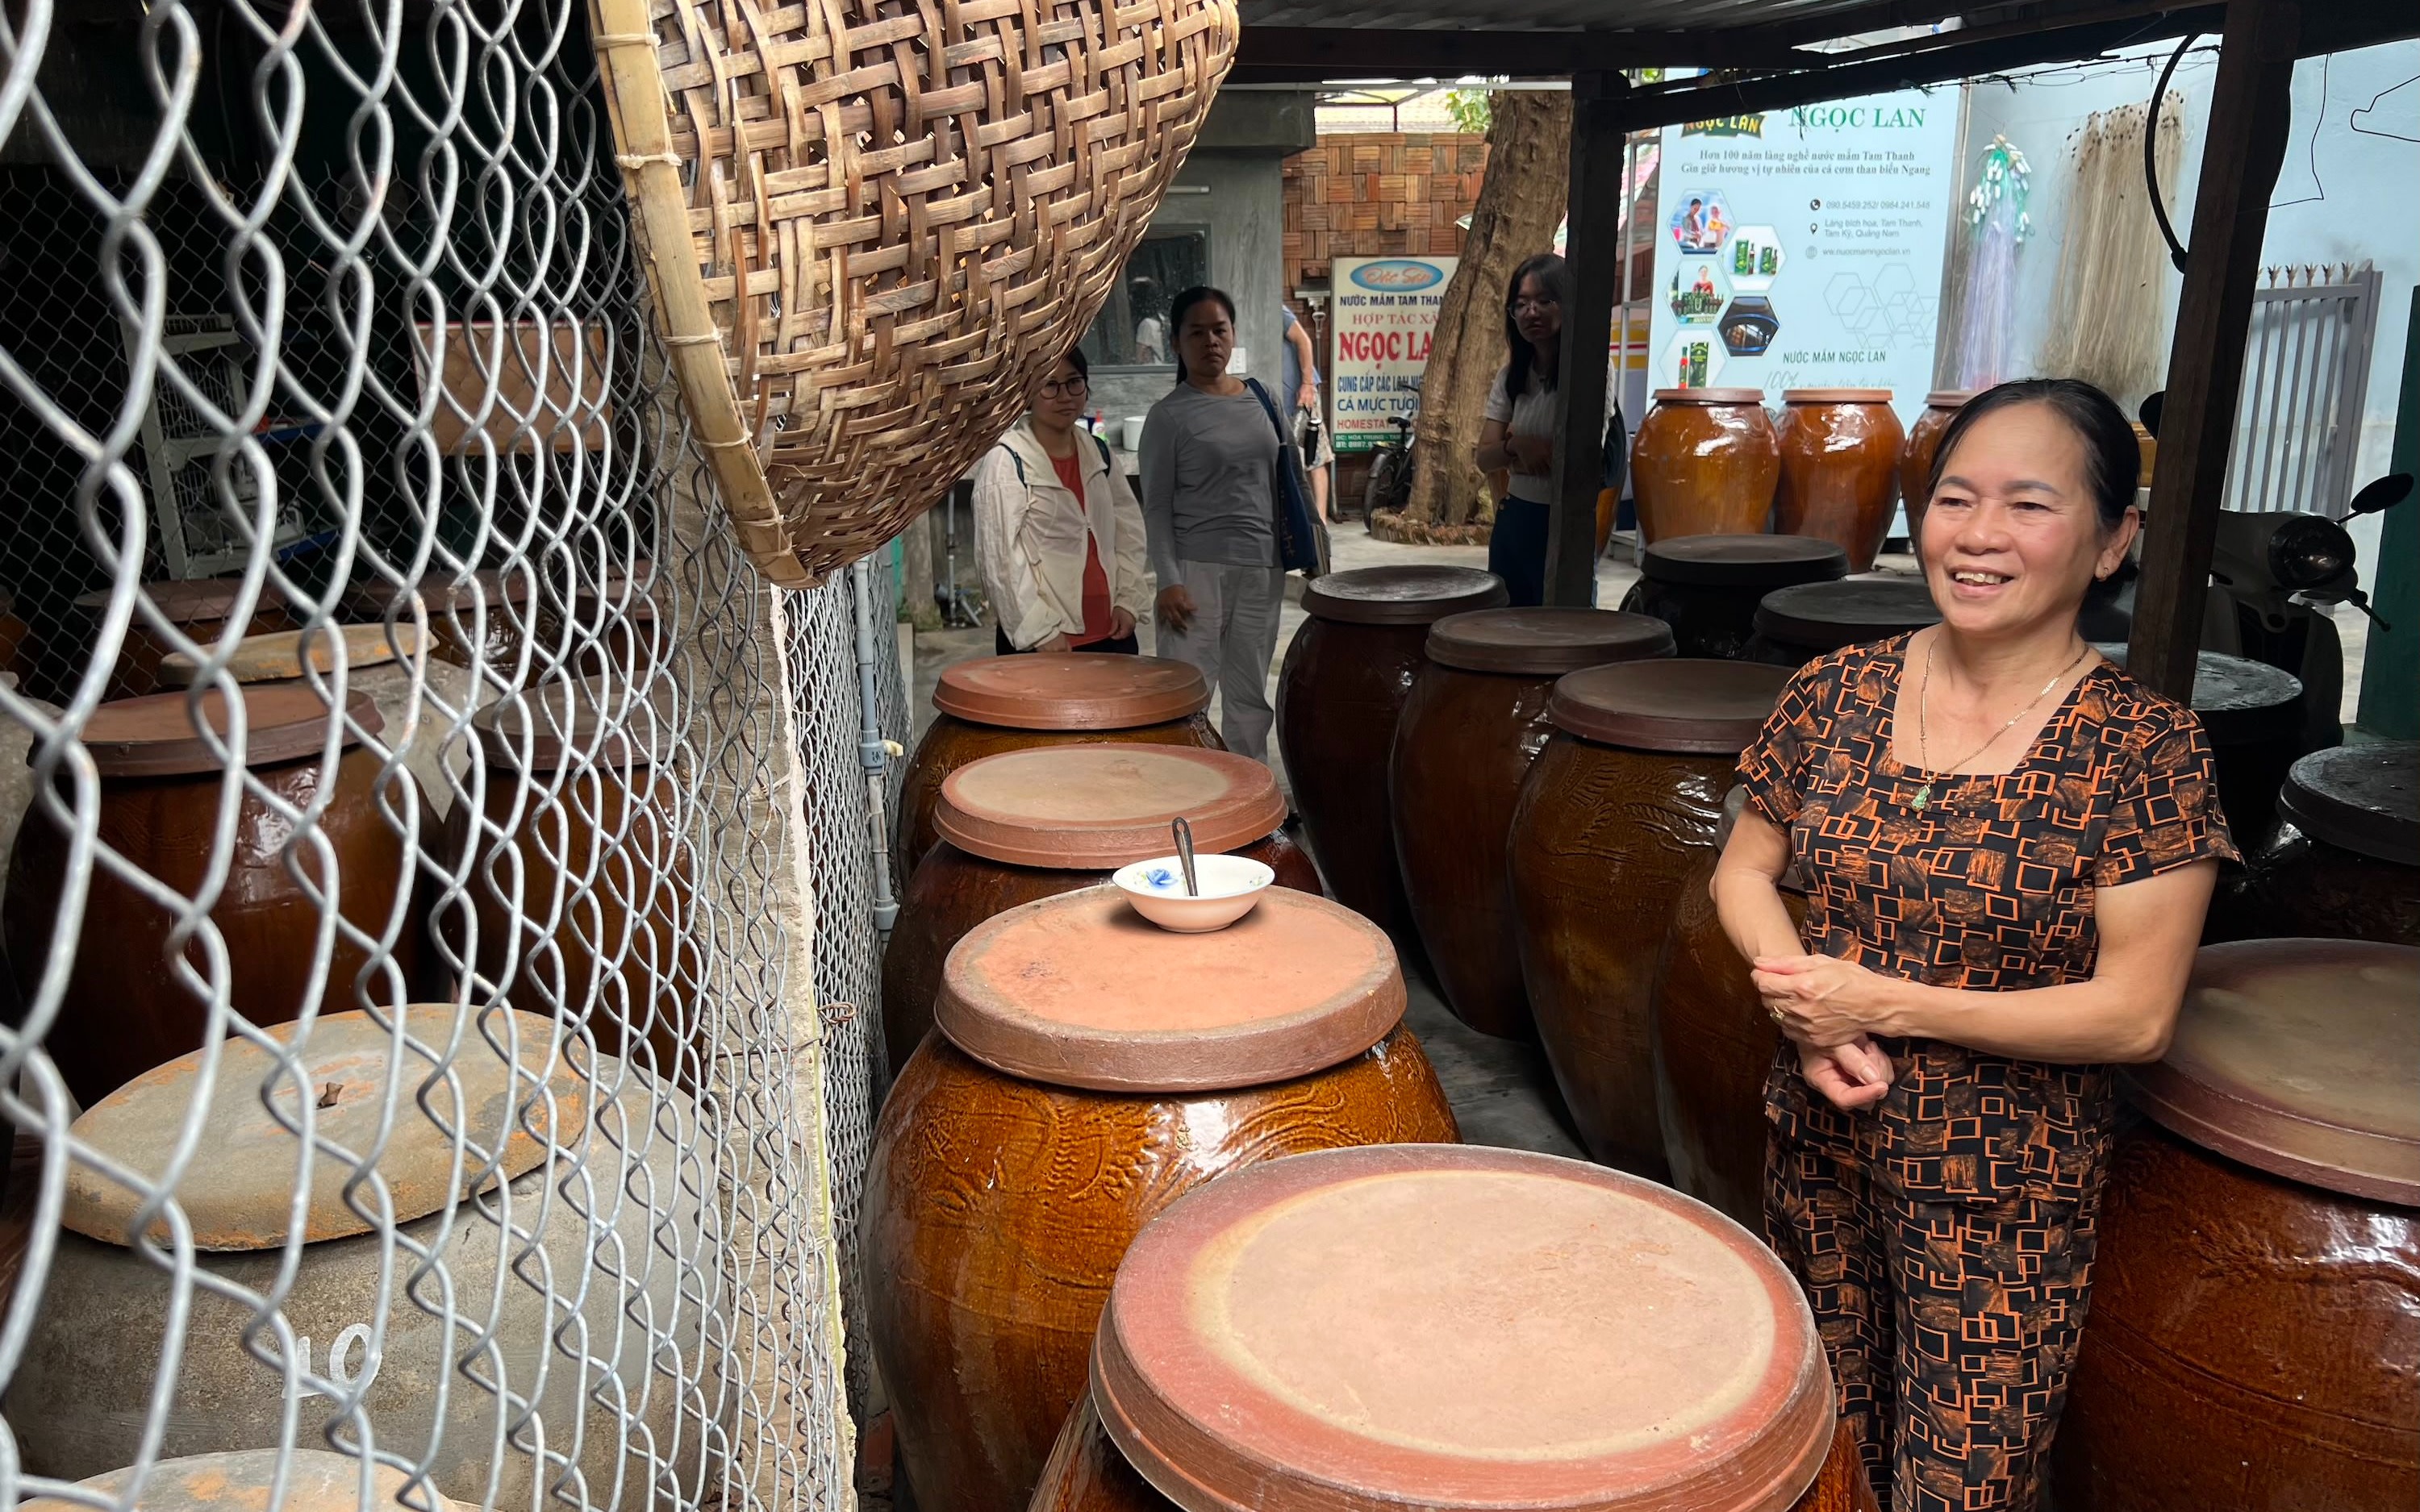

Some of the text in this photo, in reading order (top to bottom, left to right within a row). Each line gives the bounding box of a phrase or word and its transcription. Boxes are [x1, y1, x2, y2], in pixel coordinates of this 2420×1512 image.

[1729, 115, 1759, 134] LAN
[1788, 106, 1926, 132] NGỌC LAN
[1700, 148, 1915, 163] Hơn 100 năm làng nghề nước mắm Tam Thanh
[1751, 164, 1760, 177] vị
[1762, 165, 1773, 177] tự
[1775, 163, 1801, 173] nhiên
[1803, 165, 1819, 174] của
[1821, 165, 1832, 174] cá
[1834, 165, 1854, 174] cơm
[1856, 165, 1877, 174] than
[1880, 162, 1899, 174] biển
[1901, 165, 1930, 176] Ngang
[1881, 219, 1896, 227] Tam
[1825, 229, 1840, 238] Tam
[1882, 229, 1900, 238] Nam
[1340, 294, 1366, 306] NƯỚC
[1370, 292, 1395, 306] MẮM
[1398, 295, 1417, 306] TAM
[1353, 313, 1383, 327] HỢP
[1387, 310, 1416, 324] TÁC
[1338, 331, 1401, 369] NGỌC
[1839, 350, 1864, 365] NGỌC
[1867, 350, 1886, 363] LAN
[1337, 376, 1357, 392] CUNG
[1359, 370, 1374, 392] CẤP
[1376, 372, 1391, 392] CÁC
[1337, 395, 1354, 410] CÁ
[1358, 397, 1386, 414] MỰC
